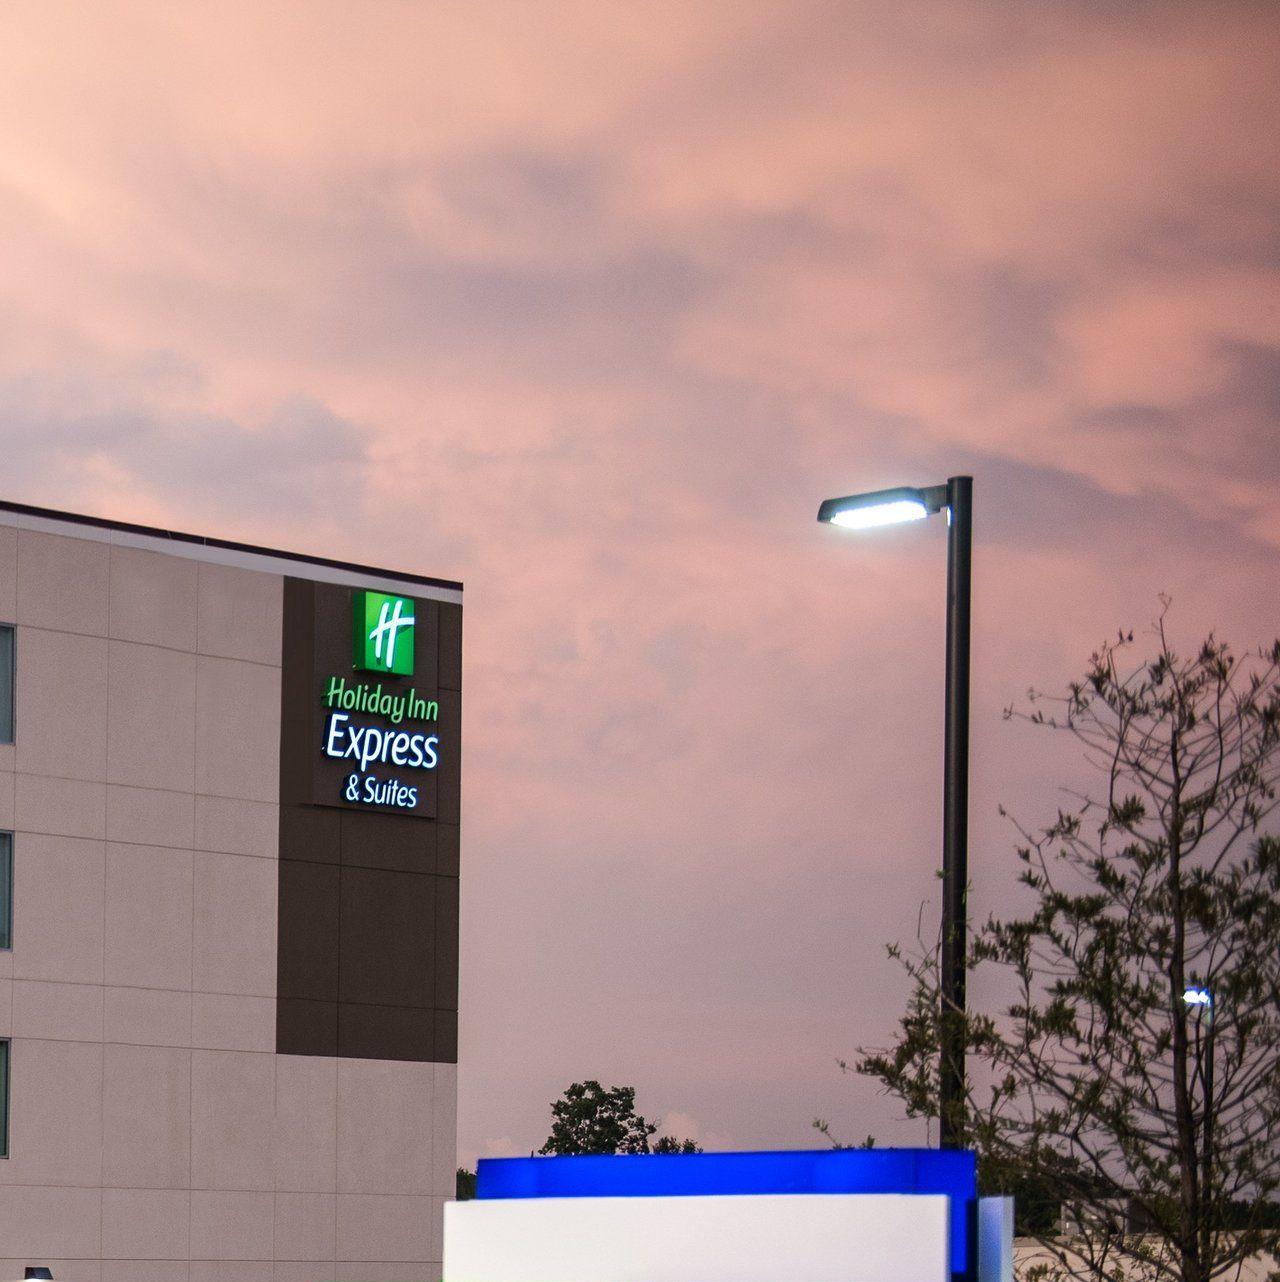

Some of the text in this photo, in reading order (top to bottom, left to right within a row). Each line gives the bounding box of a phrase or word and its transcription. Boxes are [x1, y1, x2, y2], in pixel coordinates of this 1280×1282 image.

[327, 676, 439, 724] Holiday Inn
[326, 713, 439, 772] Express
[345, 774, 418, 808] & Suites
